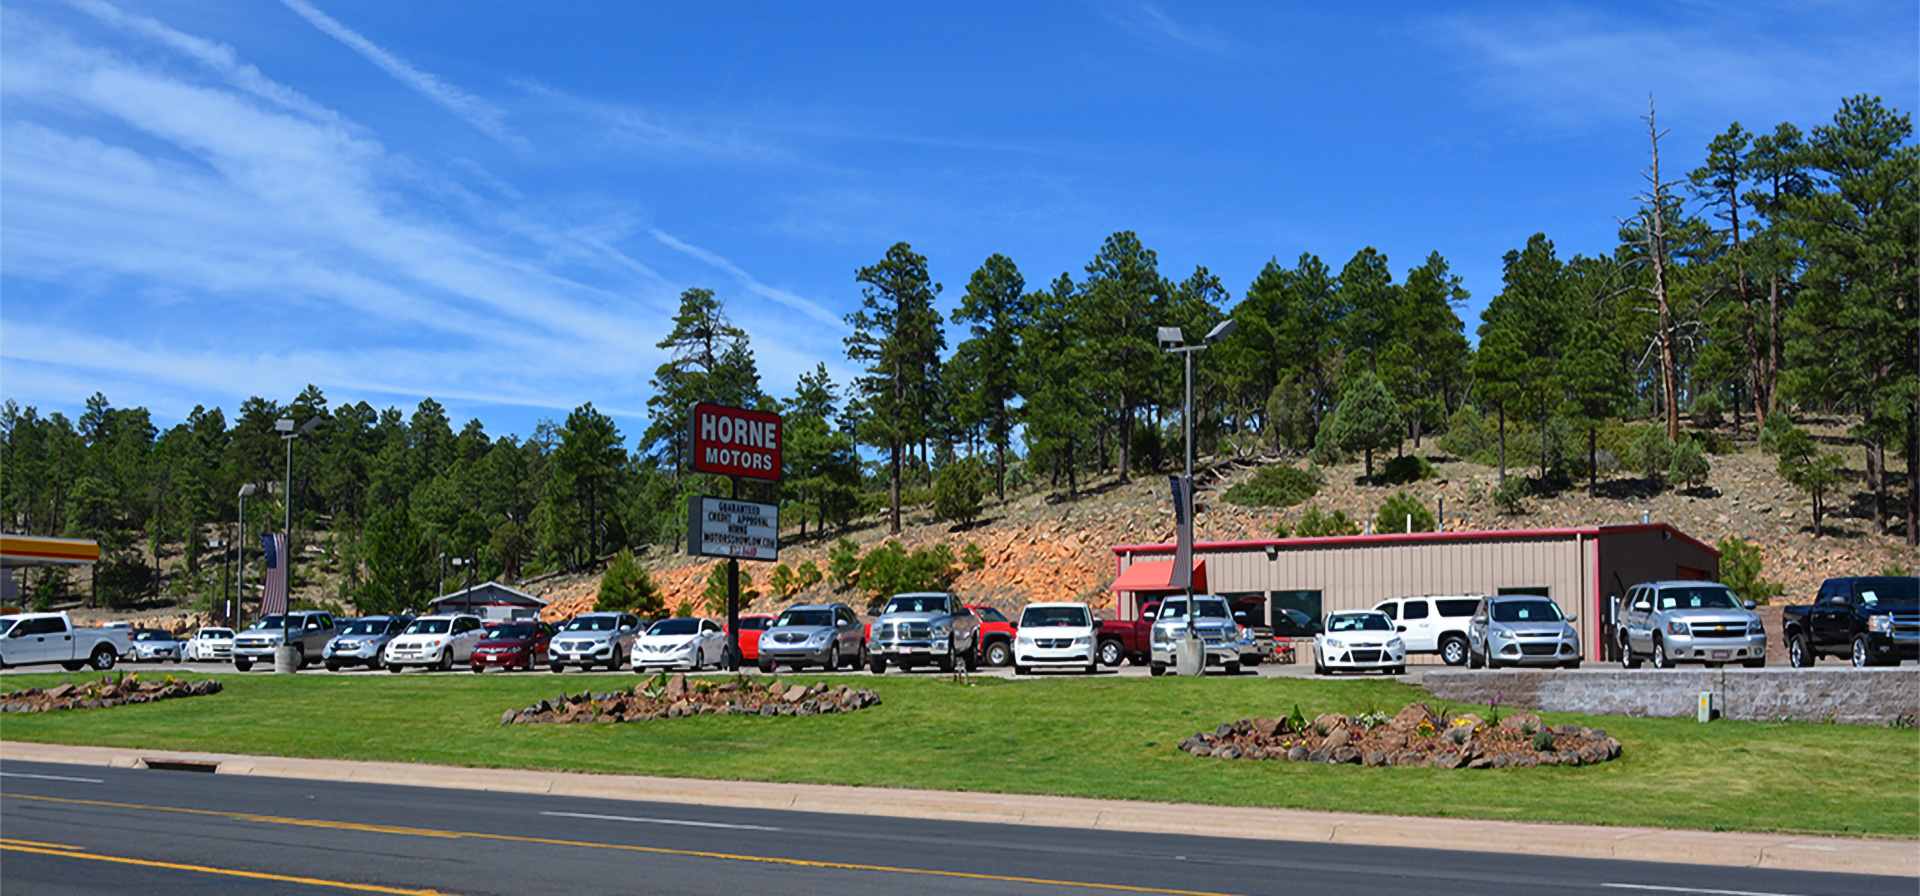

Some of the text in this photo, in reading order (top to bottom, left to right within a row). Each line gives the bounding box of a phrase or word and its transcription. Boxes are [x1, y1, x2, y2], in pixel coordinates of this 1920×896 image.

[701, 413, 777, 450] HORNE
[705, 446, 772, 471] MOTORS
[718, 501, 761, 515] GUARANTEED
[708, 511, 769, 527] CREDIT APPROVAL
